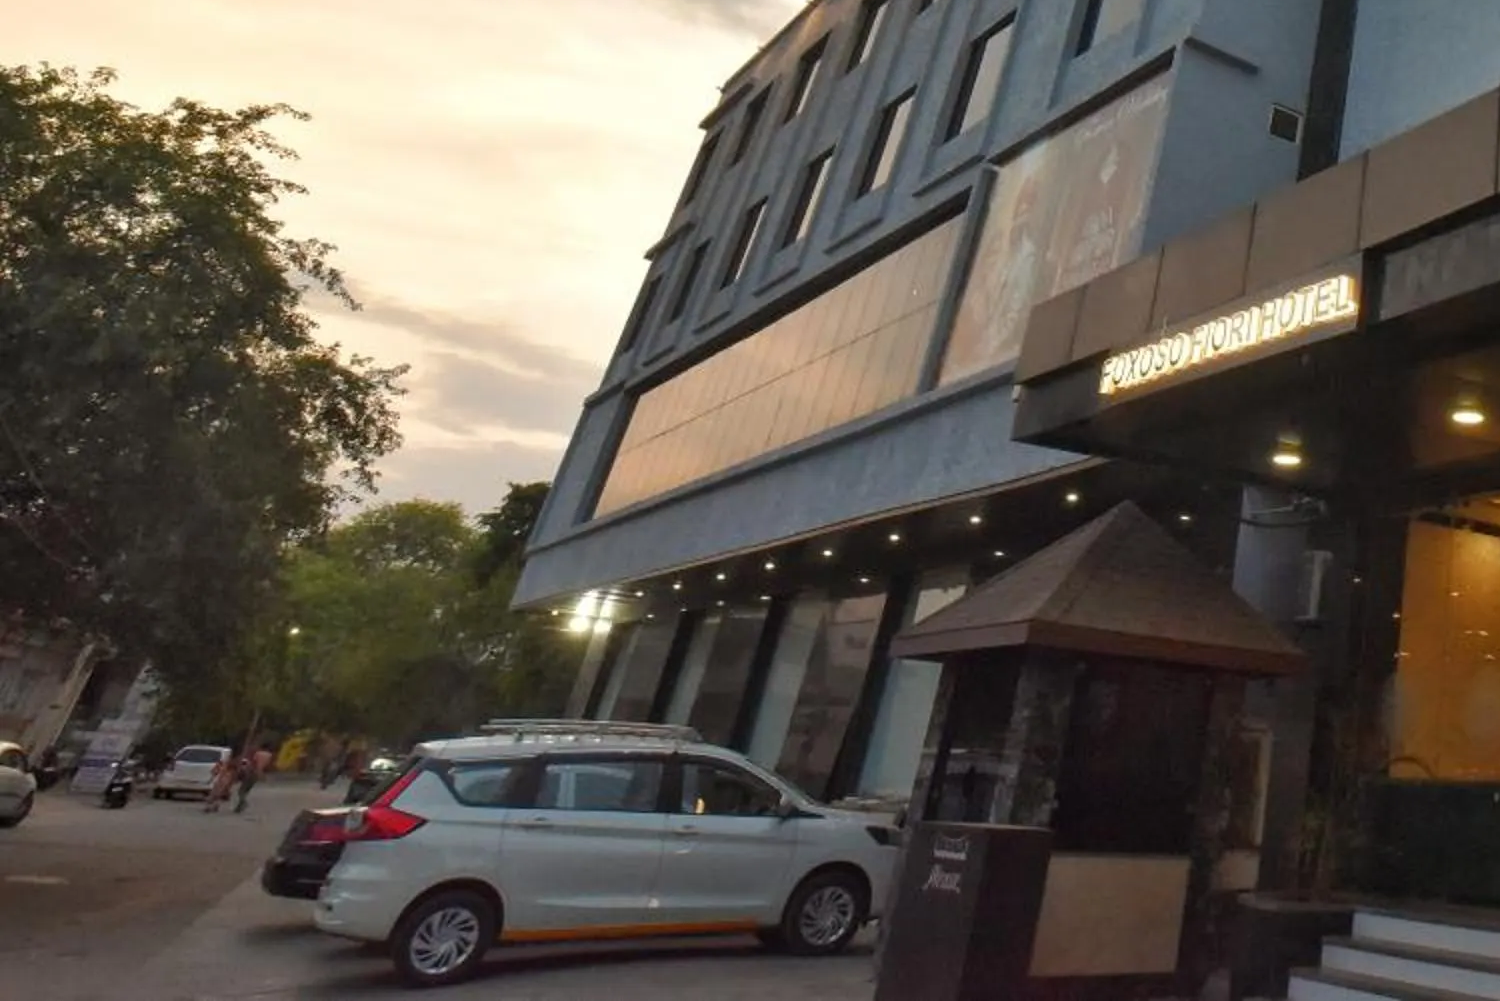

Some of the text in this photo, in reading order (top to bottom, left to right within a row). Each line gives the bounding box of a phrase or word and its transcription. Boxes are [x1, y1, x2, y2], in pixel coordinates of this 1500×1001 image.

[1098, 273, 1358, 395] FOXOSO FIORI HOTEL
